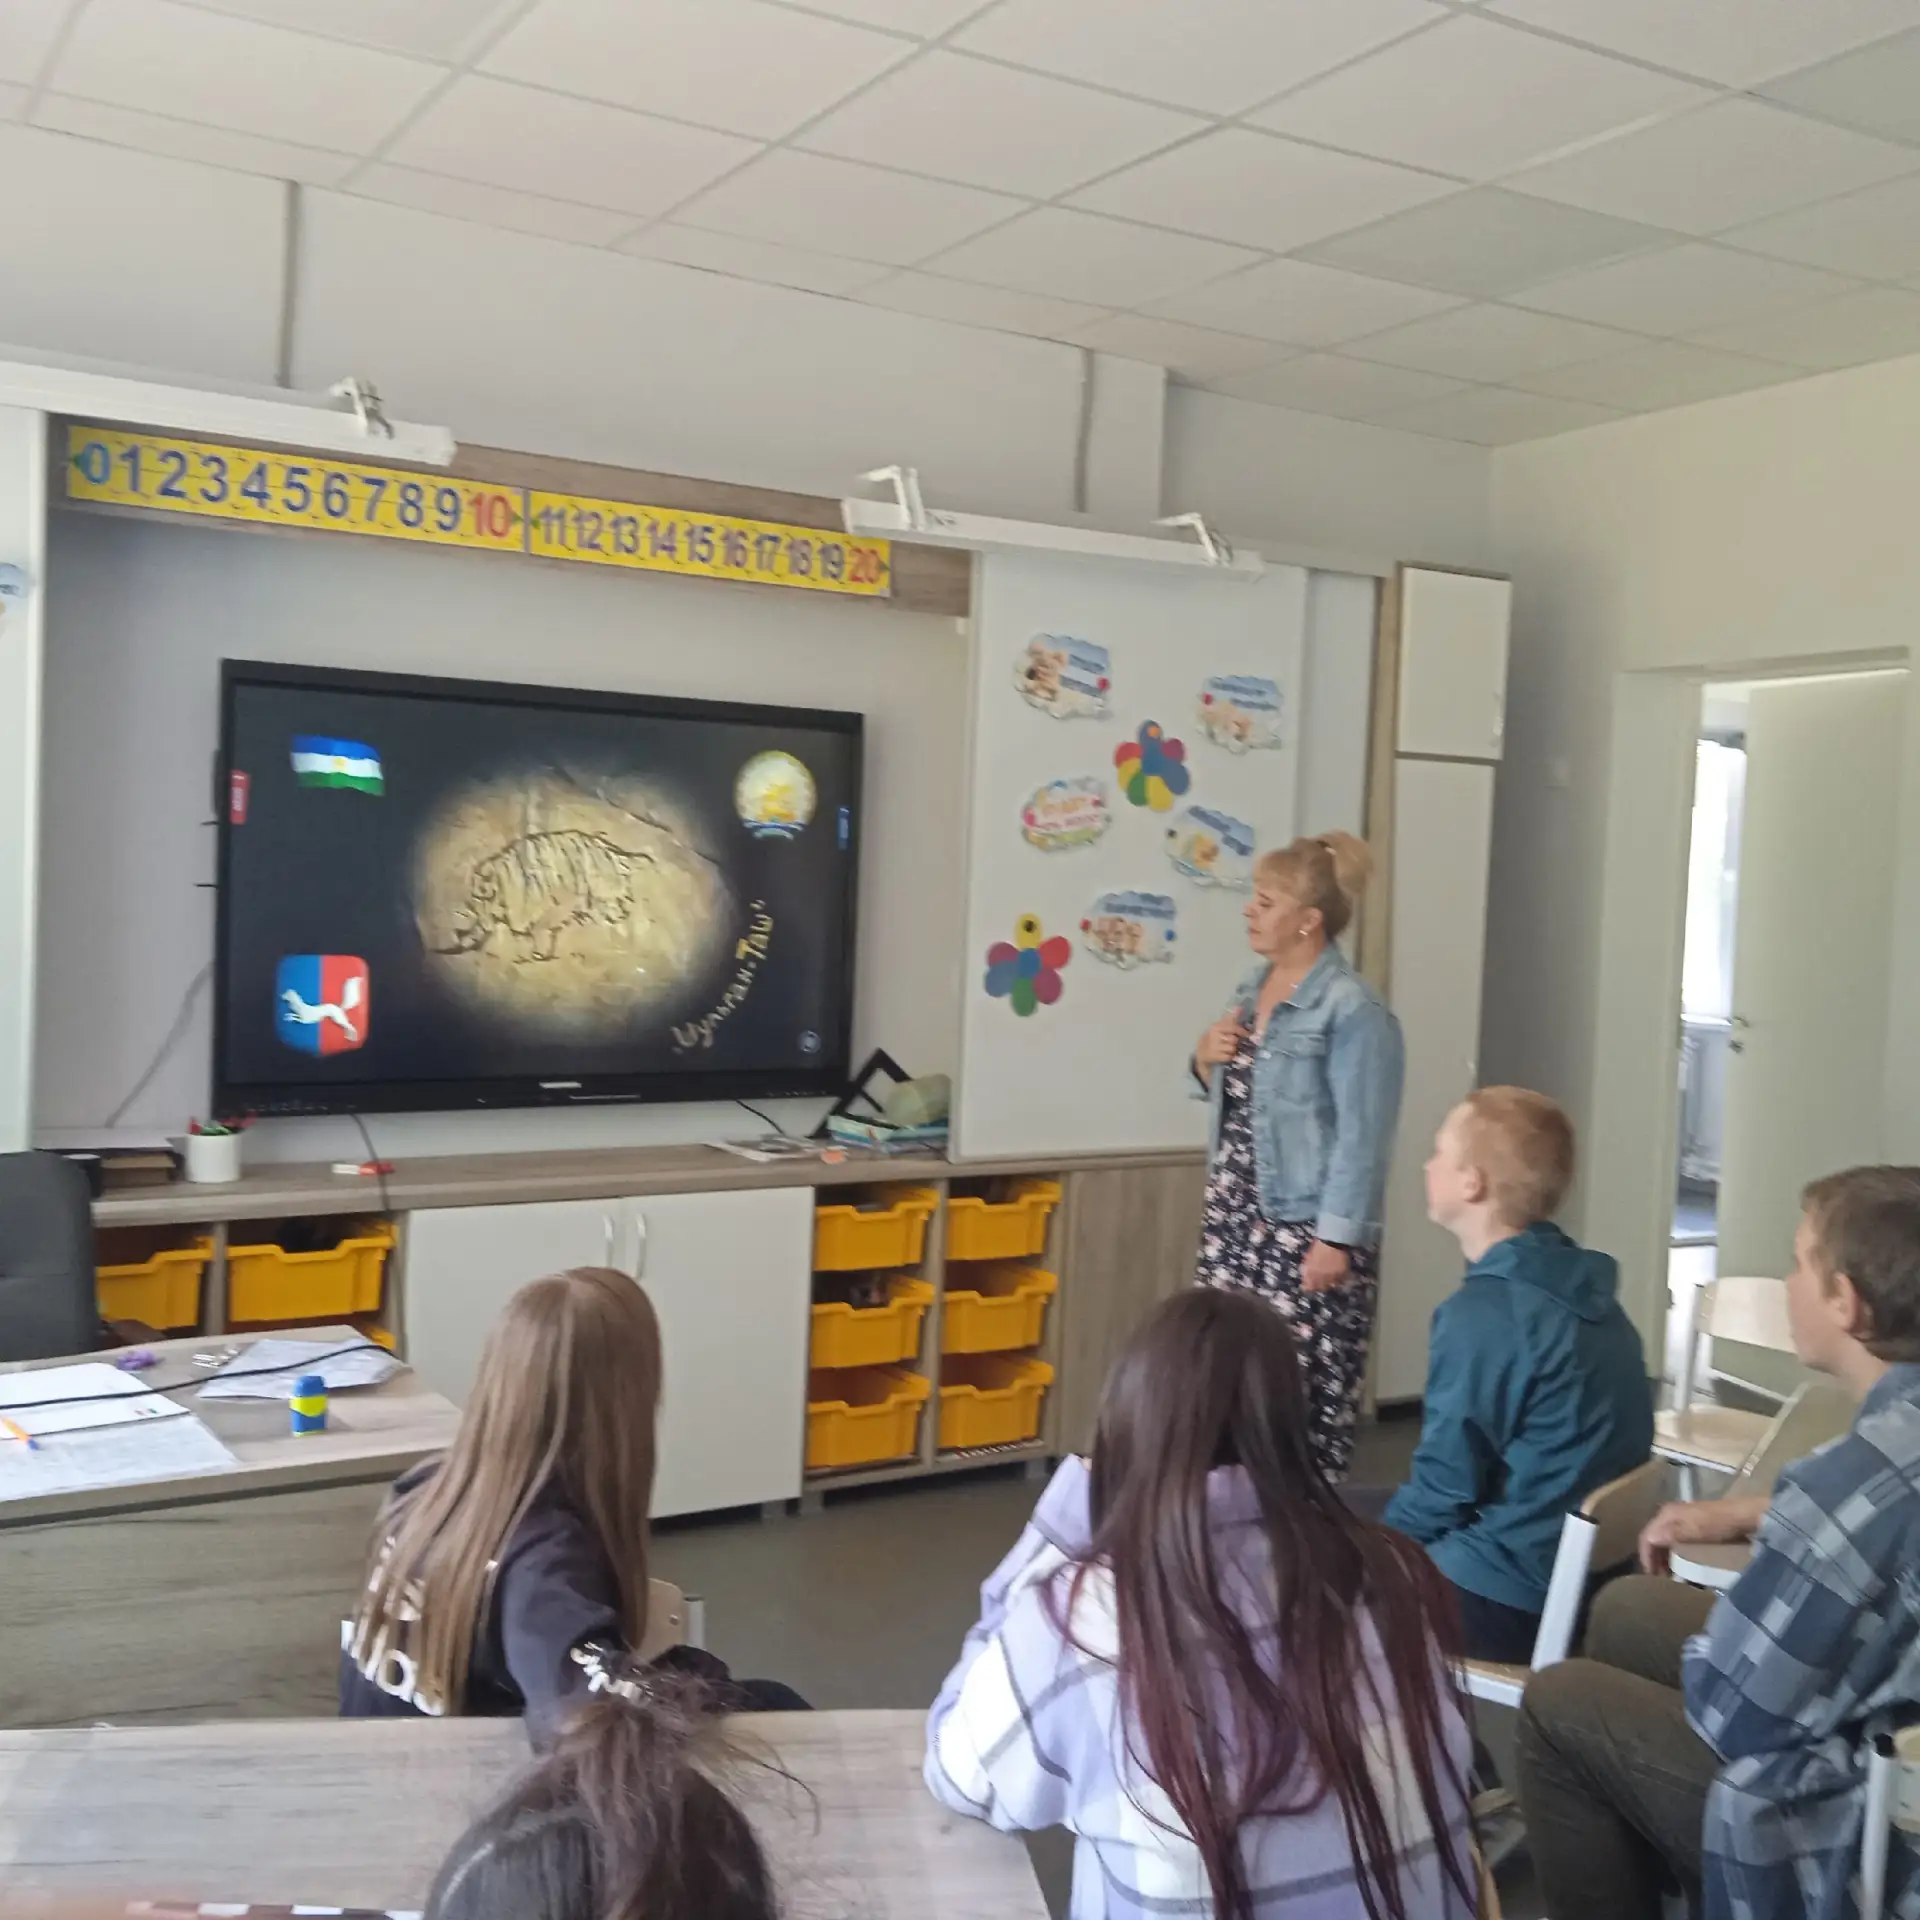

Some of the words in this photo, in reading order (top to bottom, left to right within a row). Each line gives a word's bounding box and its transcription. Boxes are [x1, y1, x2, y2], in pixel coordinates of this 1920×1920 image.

[80, 442, 111, 485] 0
[121, 444, 142, 492] 1
[158, 451, 187, 499] 2
[200, 456, 228, 503] 3
[241, 462, 270, 509] 4
[283, 467, 311, 513] 5
[323, 472, 349, 518] 6
[361, 478, 387, 522] 7
[398, 483, 424, 528] 8
[435, 488, 462, 532] 9
[469, 493, 511, 538] 10
[541, 505, 566, 545] 11
[573, 511, 603, 551] 12
[612, 515, 639, 555] 13
[647, 518, 676, 559] 14
[687, 525, 715, 564] 15
[721, 529, 747, 568] 16
[755, 534, 780, 571] 17
[788, 539, 812, 576] 18
[819, 543, 844, 580] 19
[849, 547, 880, 584] 20
